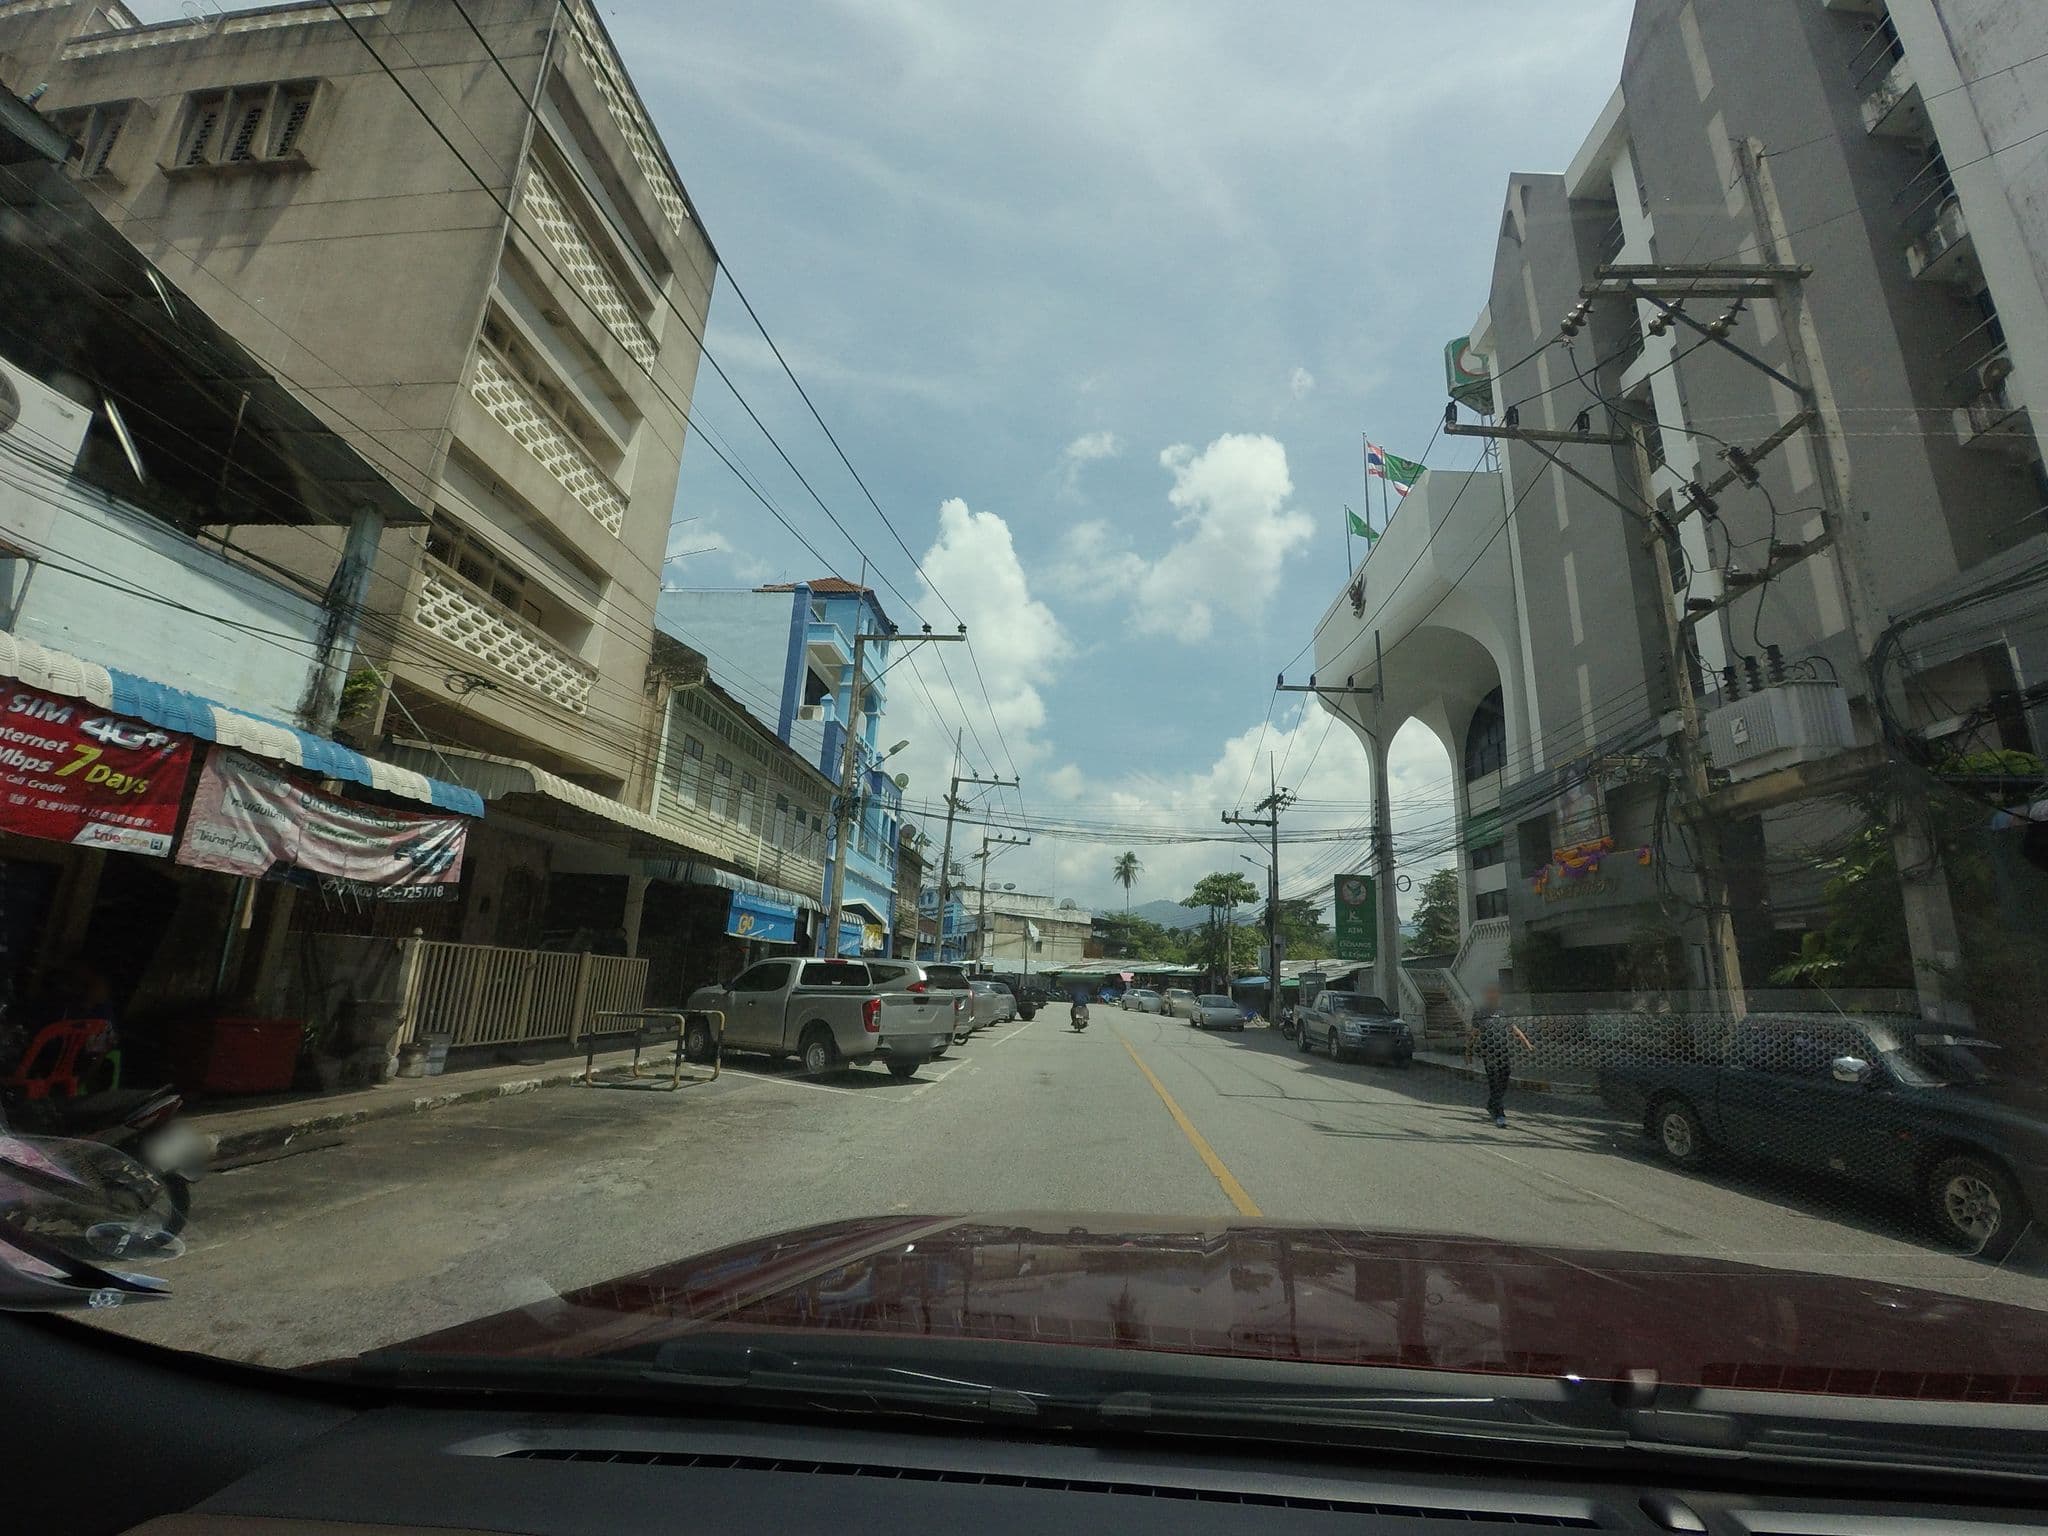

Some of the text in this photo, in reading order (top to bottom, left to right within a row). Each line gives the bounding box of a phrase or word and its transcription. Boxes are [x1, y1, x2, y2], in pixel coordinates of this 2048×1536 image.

[8, 694, 74, 725] SIM
[54, 744, 103, 777] 7
[84, 764, 149, 795] Days
[6, 774, 66, 793] Call Credit
[1347, 927, 1363, 935] ATM
